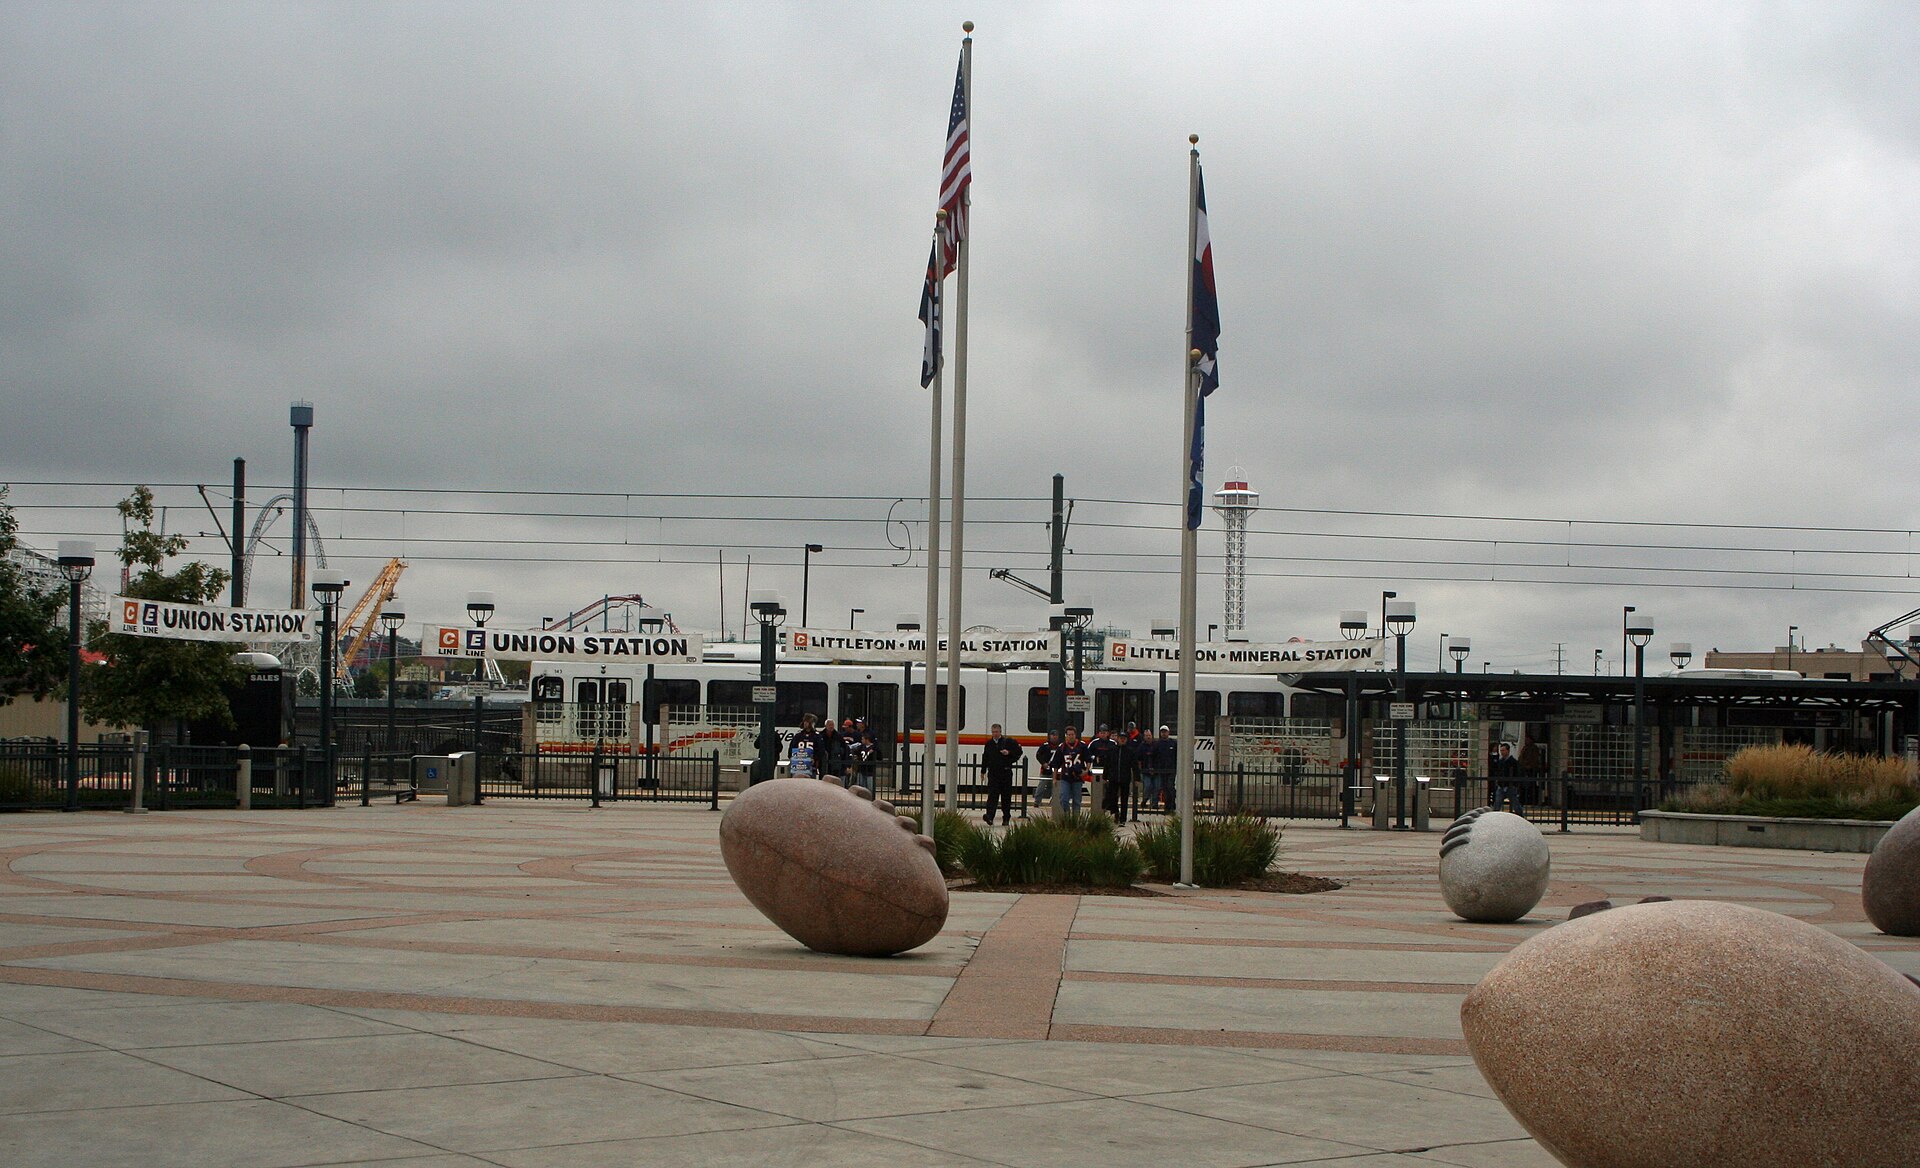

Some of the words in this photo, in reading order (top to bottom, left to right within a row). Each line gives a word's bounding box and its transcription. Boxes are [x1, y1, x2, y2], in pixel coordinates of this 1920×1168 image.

[163, 608, 225, 631] UNION
[231, 613, 305, 633] STATION
[123, 624, 137, 632] LINE
[143, 626, 158, 634] LINE
[493, 633, 575, 654] UNION
[583, 637, 687, 656] STATION
[811, 636, 896, 650] LITTLETON
[908, 640, 977, 651] MIEAL
[982, 640, 1048, 651] STATION
[438, 648, 458, 656] LINE
[1130, 647, 1217, 661] LITTLEON
[1229, 650, 1301, 662] MINERAL
[1305, 648, 1371, 661] STATION
[250, 674, 280, 682] SALES
[1196, 739, 1215, 750] Th
